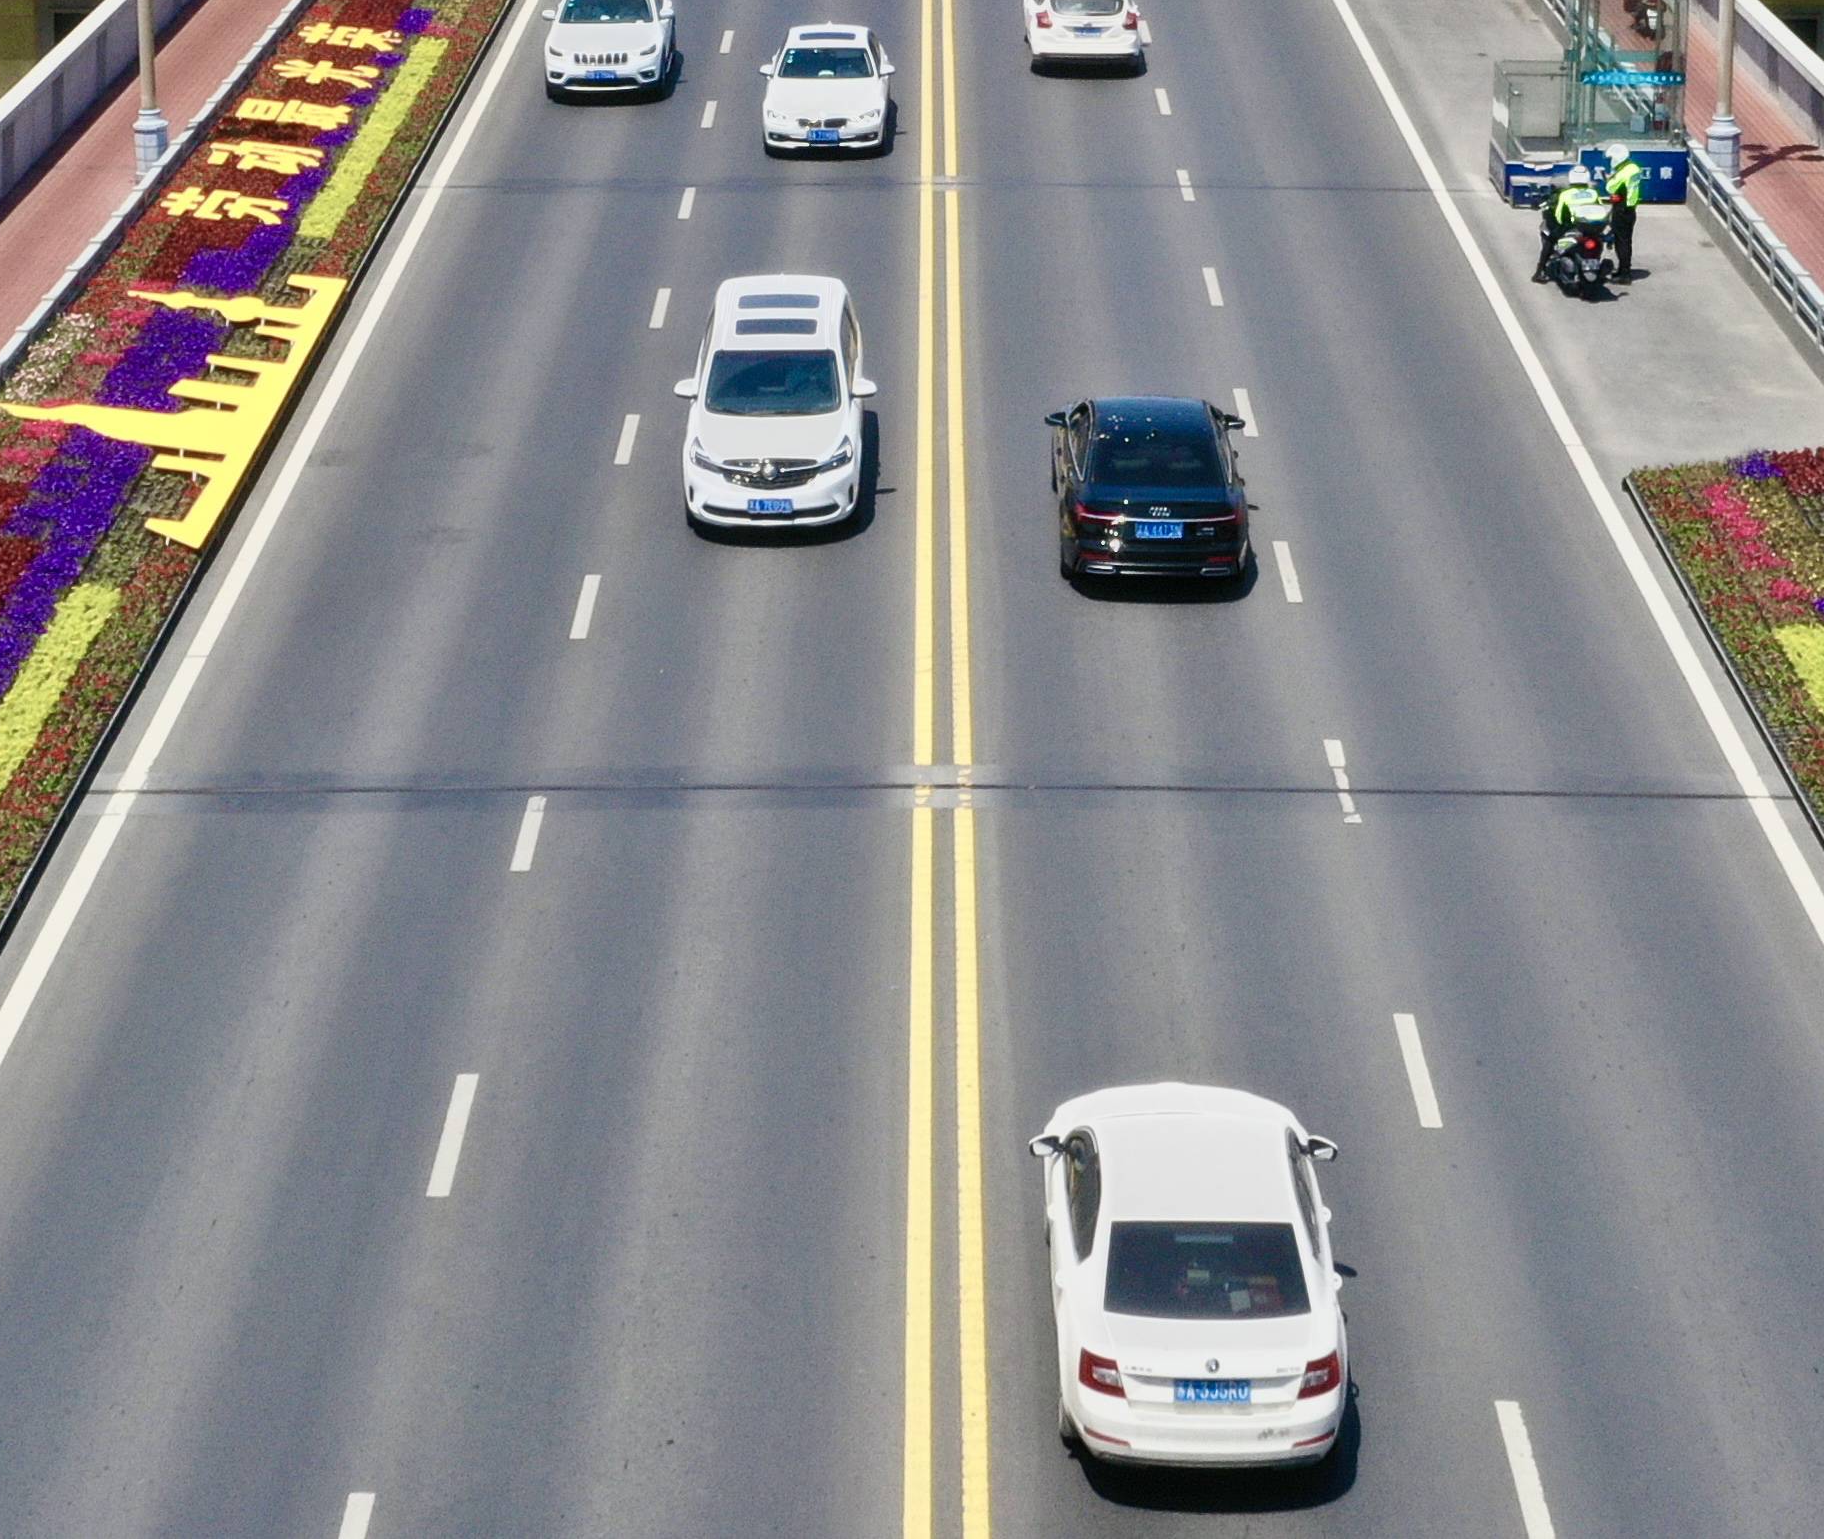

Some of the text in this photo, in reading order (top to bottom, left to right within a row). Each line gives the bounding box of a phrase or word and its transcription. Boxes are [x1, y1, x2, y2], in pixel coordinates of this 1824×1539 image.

[160, 22, 403, 225] 劳动最光荣
